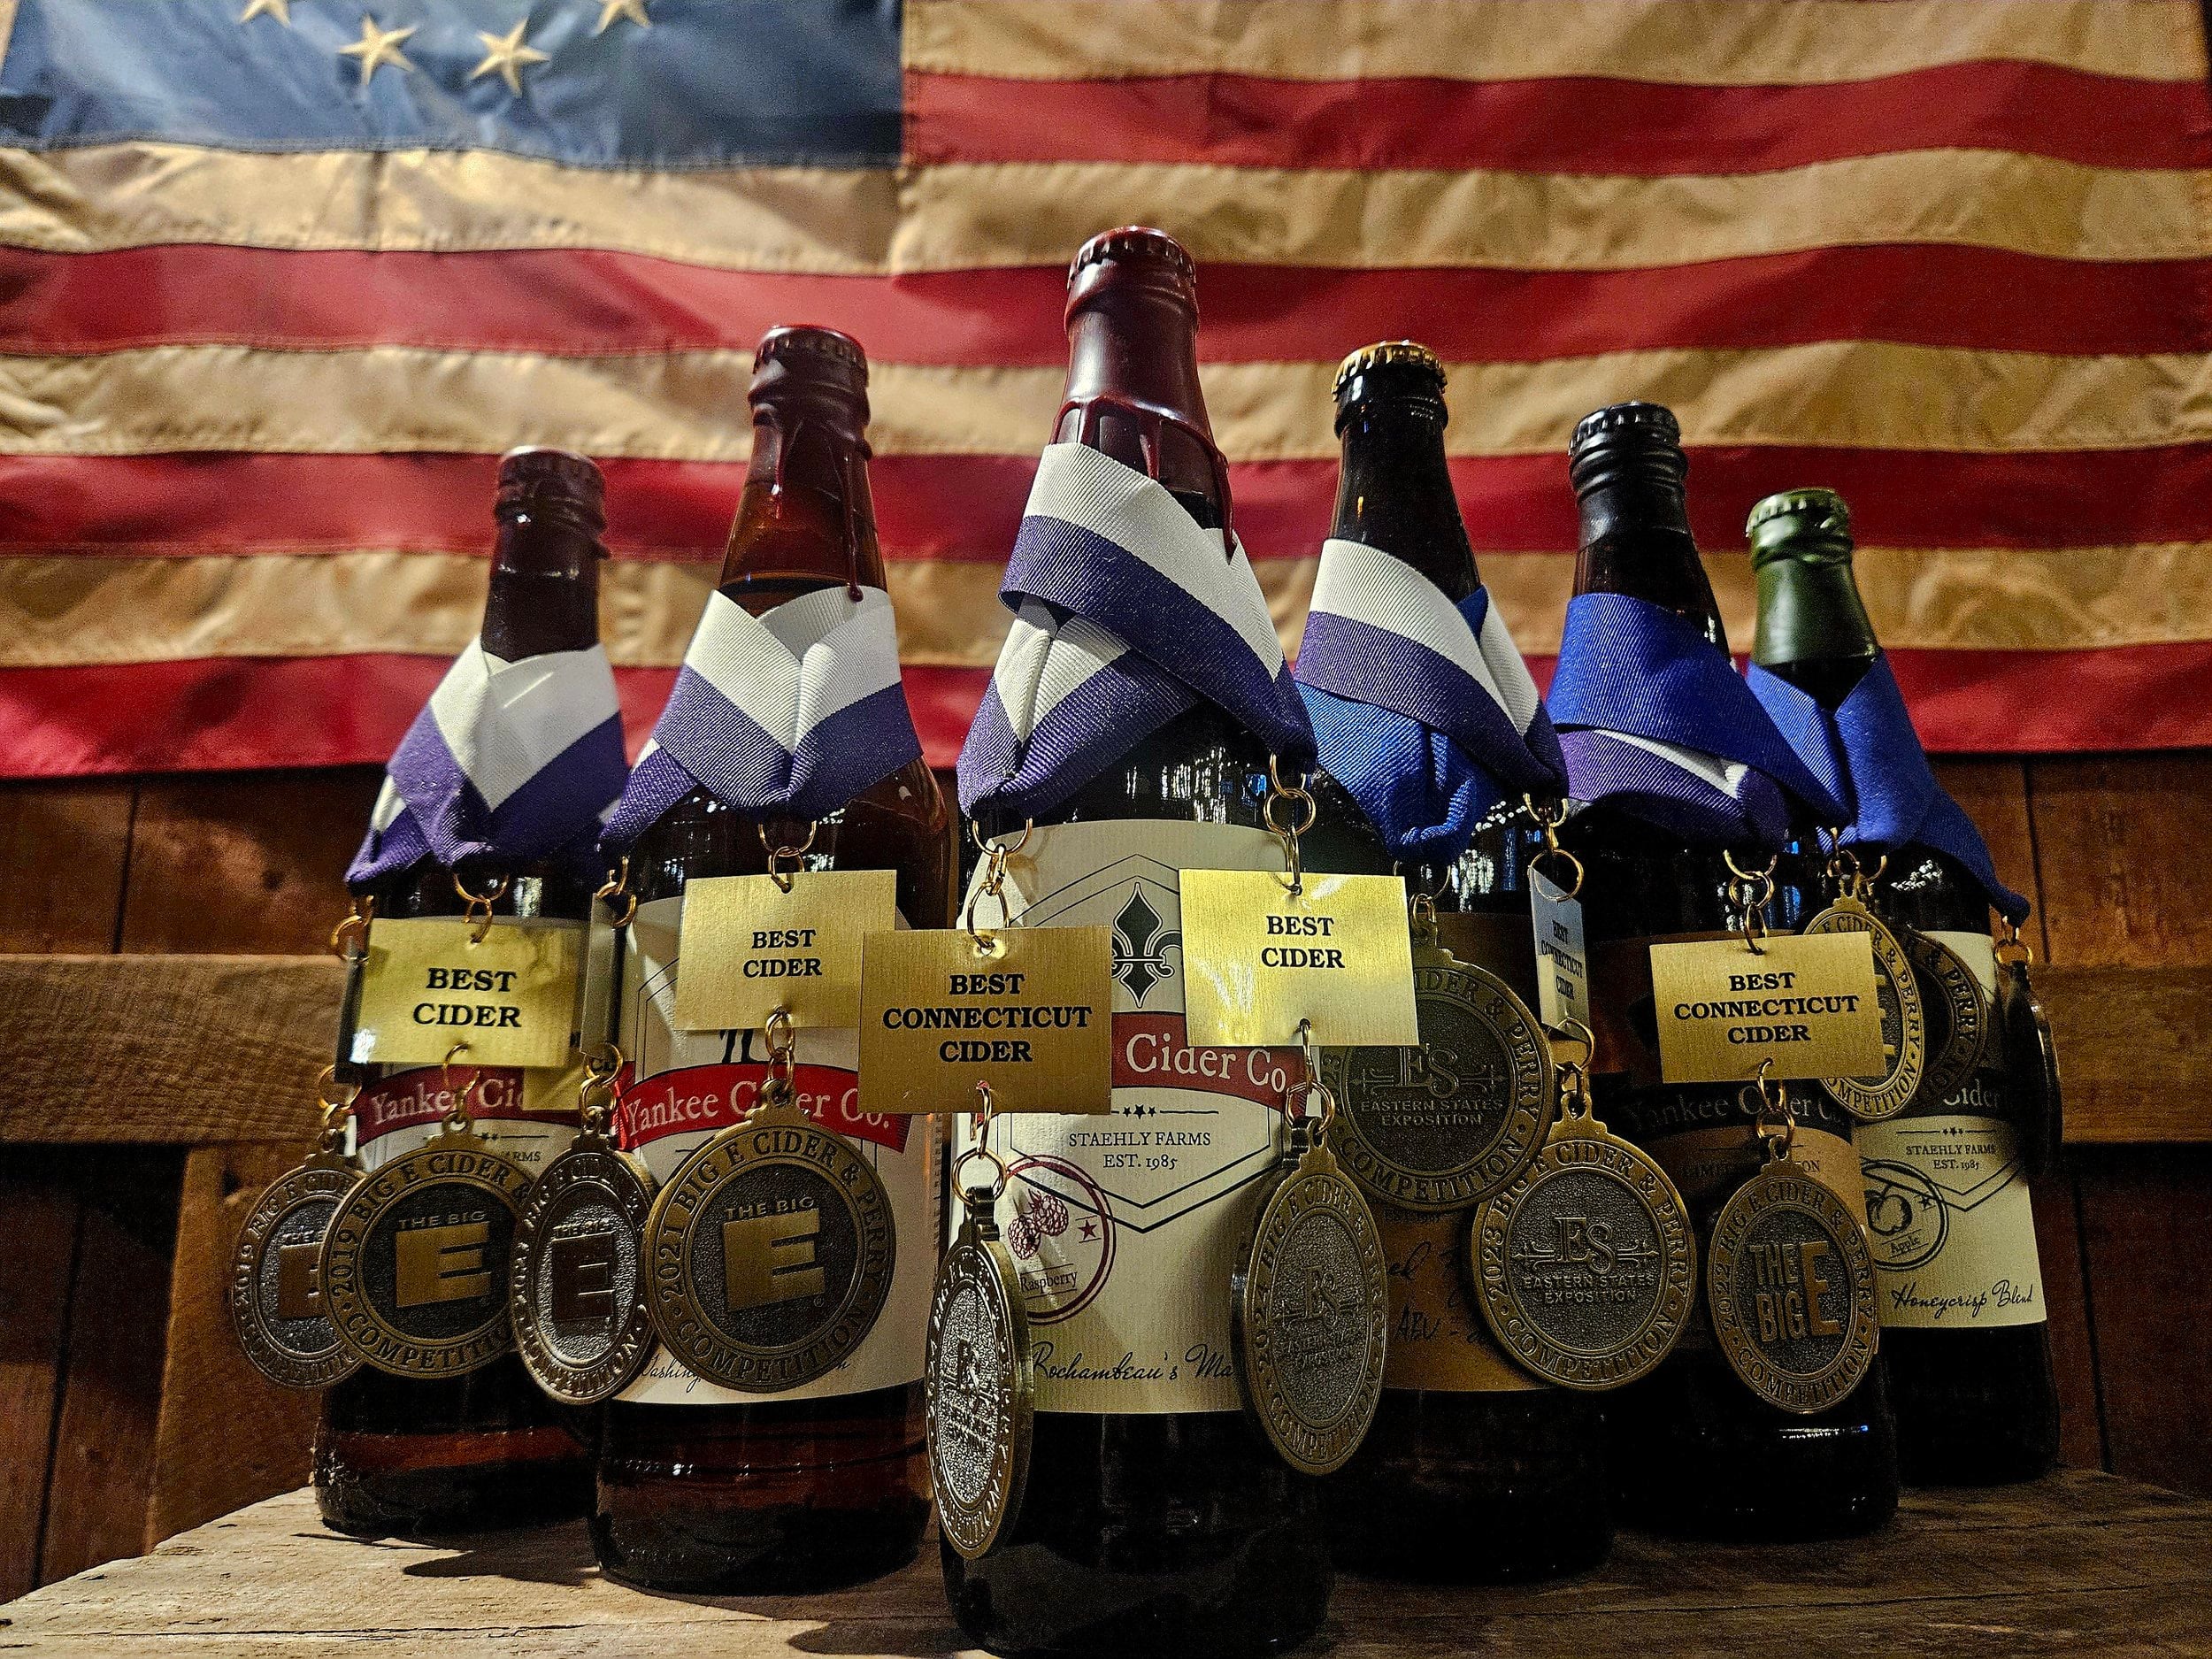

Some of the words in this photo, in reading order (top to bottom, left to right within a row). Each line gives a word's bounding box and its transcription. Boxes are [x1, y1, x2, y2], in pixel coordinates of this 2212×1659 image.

[751, 929, 817, 949] BEST
[1266, 915, 1334, 938] BEST
[743, 958, 823, 979] CIDER
[1261, 946, 1346, 969] CIDER
[426, 967, 518, 993] BEST
[949, 973, 1025, 996] BEST
[1729, 972, 1796, 992] BEST
[412, 1002, 522, 1028] CIDER
[883, 1006, 1092, 1030] CONNECTICUT
[1673, 995, 1860, 1021] CONNECTICUT
[1886, 949, 1897, 968] &
[1898, 971, 1921, 1050] PERRY
[1946, 969, 1979, 1043] PERRY
[939, 1040, 1033, 1063] CIDER
[1417, 970, 1479, 1005] IDER
[1509, 1024, 1542, 1122] PERRY
[1727, 1025, 1811, 1045] CIDER
[1126, 1032, 1237, 1080] Cider
[372, 1082, 457, 1126] Yanke
[1361, 1100, 1434, 1113] EASTERN
[1440, 1098, 1504, 1112] STATES
[1738, 1086, 1811, 1118] Cer
[1826, 1064, 1917, 1116] OMPETITION
[626, 1087, 726, 1137] Yankee
[730, 1081, 830, 1118] Cer
[1381, 1113, 1483, 1127] EXPOSITION
[1069, 1131, 1151, 1148] STAEHLY
[1155, 1131, 1211, 1146] FARMS
[1103, 1155, 1142, 1169] EST.
[1146, 1155, 1178, 1171] 1985
[1340, 1135, 1525, 1200] COMPETITION
[1933, 1159, 1959, 1170] EST.
[658, 1226, 686, 1303] 2021
[673, 1162, 719, 1216] BIG
[725, 1141, 746, 1167] E
[752, 1130, 840, 1169] CIDER
[841, 1163, 862, 1187] &
[856, 1193, 886, 1289] PERRY
[724, 1202, 768, 1221] THE
[776, 1194, 816, 1214] BIG
[1747, 1191, 1763, 1214] E
[1766, 1181, 1825, 1215] CIDER
[330, 1229, 355, 1298] 2019
[351, 1182, 396, 1220] BIG
[400, 1163, 420, 1185] E
[427, 1154, 512, 1186] CIDER
[399, 1215, 440, 1230] THE
[446, 1210, 486, 1224] BIG
[1483, 1228, 1509, 1302] 2023
[1555, 1141, 1636, 1180] CIDER
[1638, 1174, 1657, 1200] &
[1656, 1202, 1689, 1299] PERRY
[1720, 1208, 1747, 1252] BIG
[723, 1208, 826, 1316] E
[1554, 1216, 1616, 1274] ES
[1748, 1242, 1799, 1285] THE
[396, 1221, 492, 1309] E
[551, 1229, 615, 1322] E
[1020, 1271, 1078, 1294] Raspberry
[1524, 1276, 1593, 1290] EASTERN
[1599, 1274, 1655, 1288] STATES
[1543, 1288, 1638, 1304] EXPOSITION
[1712, 1263, 1739, 1332] 2022
[1800, 1240, 1841, 1337] E
[1891, 1281, 1988, 1320] Honeycrisp
[1992, 1279, 2033, 1308] Blend
[1755, 1288, 1808, 1343] BIG
[676, 1302, 869, 1383] COMPETITION
[1032, 1340, 1179, 1381] Rochambeau's
[1507, 1312, 1676, 1379] COMPETITION
[1738, 1336, 1869, 1405] COMPETITION
